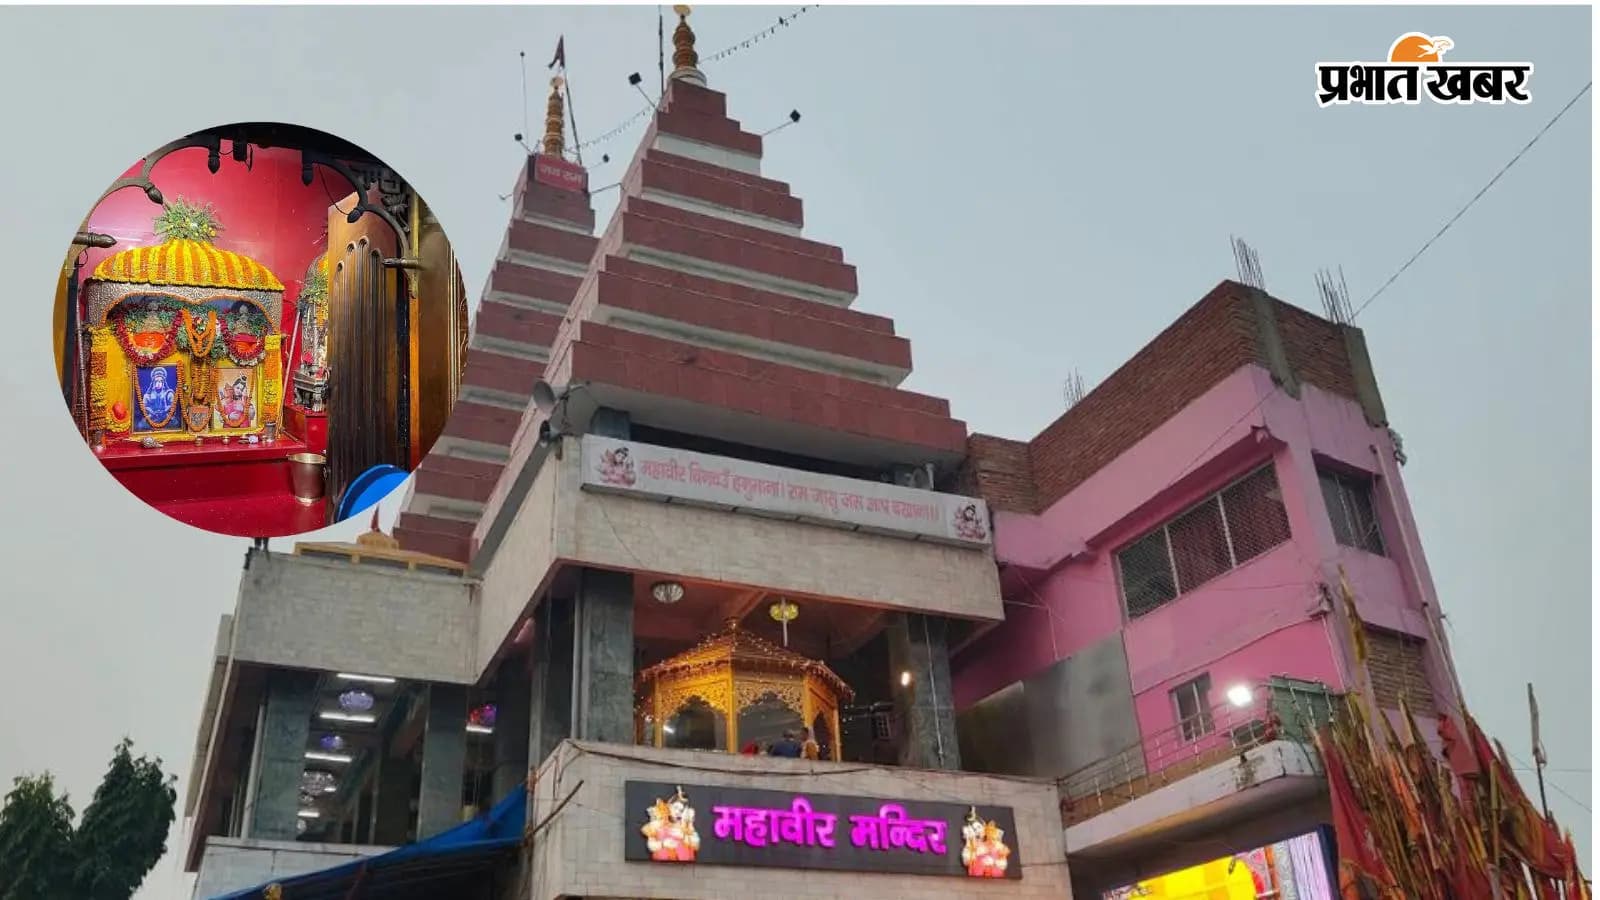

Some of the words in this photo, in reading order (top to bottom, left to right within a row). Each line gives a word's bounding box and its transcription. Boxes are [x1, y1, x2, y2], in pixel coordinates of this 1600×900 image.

[640, 458, 685, 483] महावीर
[712, 795, 838, 849] महावीर
[849, 803, 947, 855] मन्दिर
